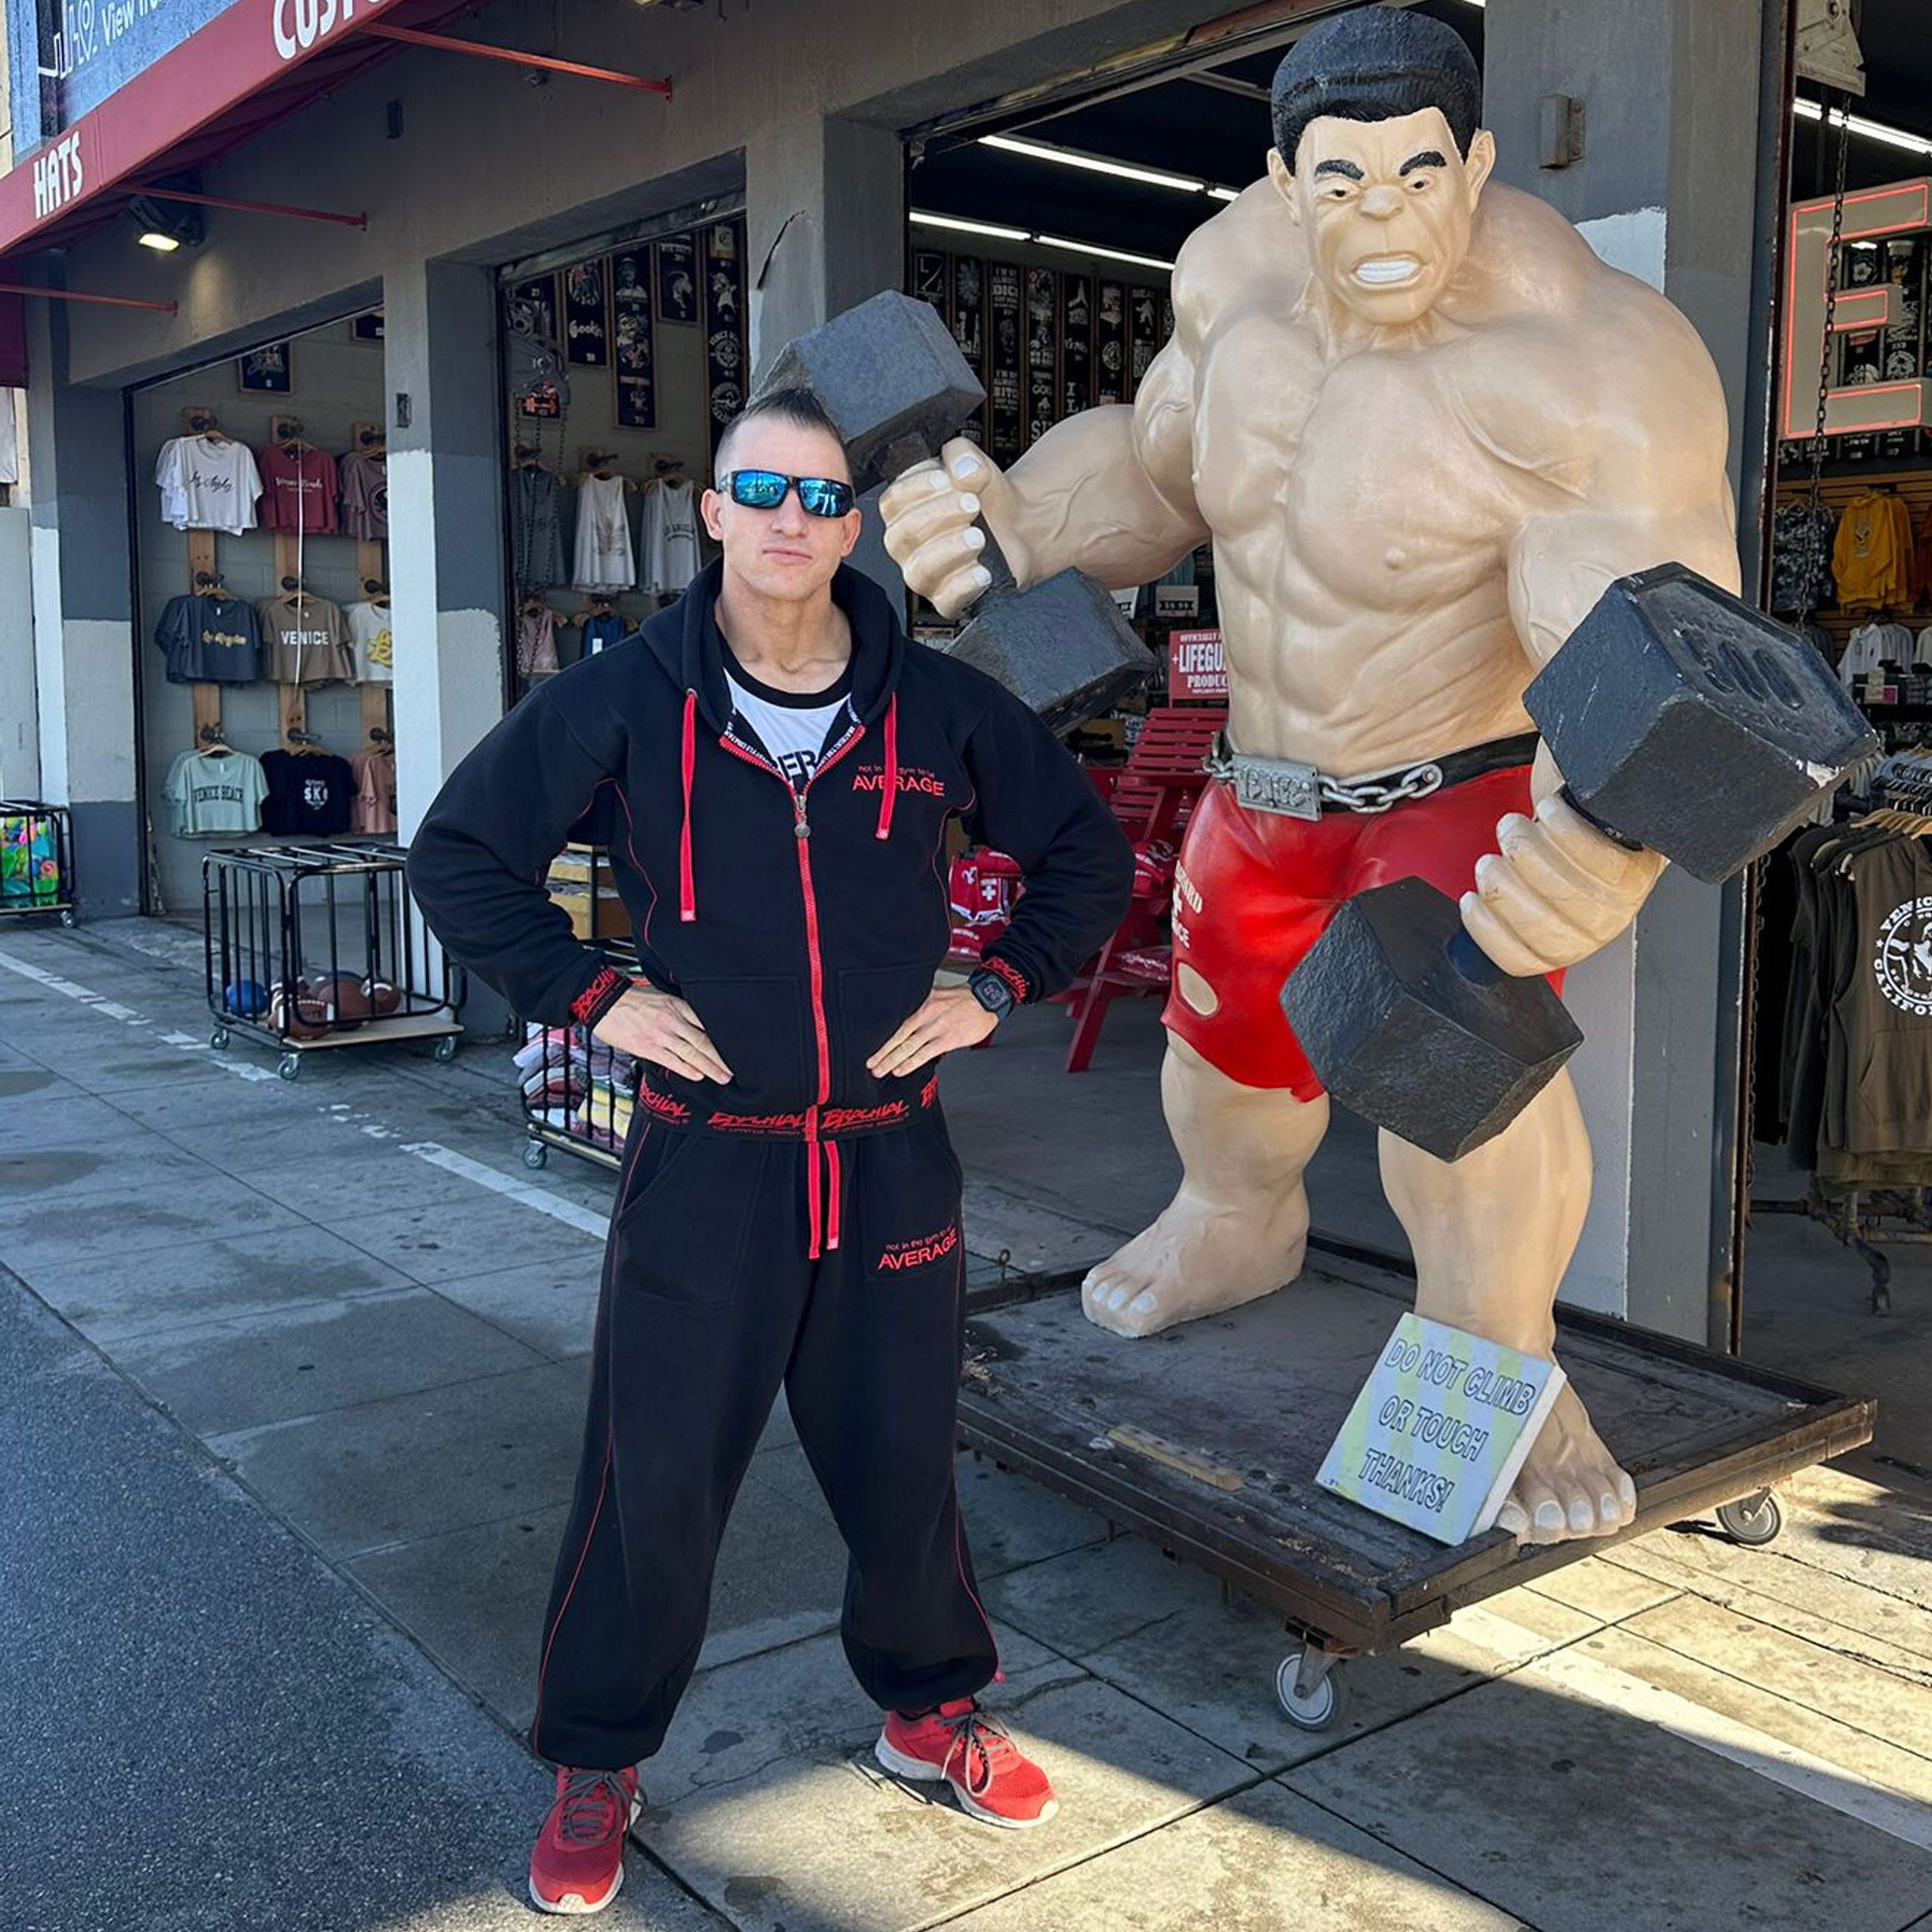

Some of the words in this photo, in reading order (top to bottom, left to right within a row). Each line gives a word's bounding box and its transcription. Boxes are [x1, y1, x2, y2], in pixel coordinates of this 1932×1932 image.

[33, 130, 82, 220] HATS
[280, 630, 330, 646] VENICE
[1179, 643, 1226, 672] LIFEGU
[852, 774, 945, 796] AVERAGE
[878, 1227, 957, 1270] AVERAGE
[1385, 1338, 1422, 1374] DO
[1418, 1346, 1469, 1390] NOT
[1463, 1364, 1537, 1417] CLIMB
[1378, 1395, 1412, 1433] OR
[1412, 1405, 1489, 1463] TOUCH
[1358, 1447, 1456, 1514] THANKS!
